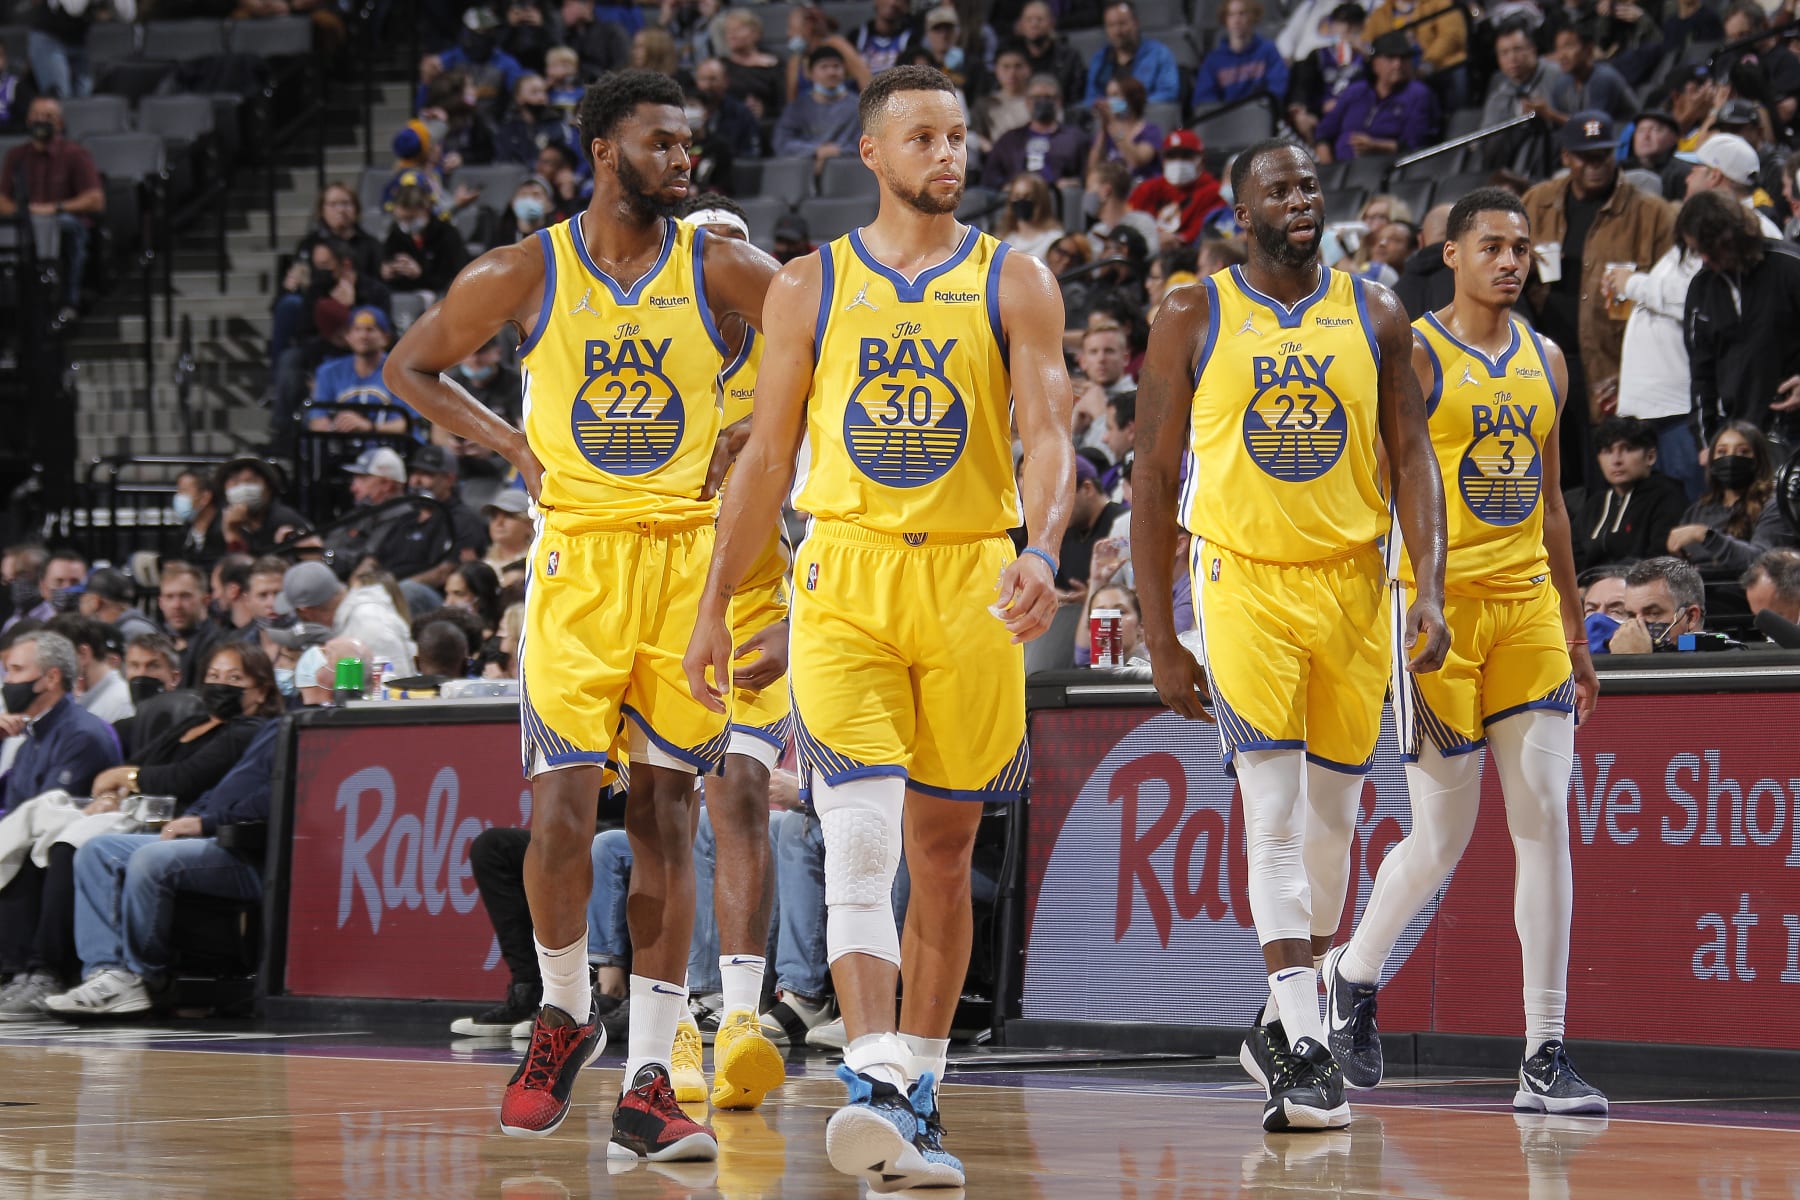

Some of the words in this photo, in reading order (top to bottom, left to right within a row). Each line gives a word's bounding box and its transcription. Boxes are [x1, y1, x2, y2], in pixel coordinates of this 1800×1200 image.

[649, 295, 690, 308] Rakuten
[934, 291, 980, 303] Rakuten
[613, 323, 640, 340] The
[891, 321, 921, 339] The
[1315, 317, 1353, 327] Rakuten
[585, 338, 673, 377] BAY
[858, 337, 958, 379] BAY
[1278, 341, 1303, 355] The
[1252, 354, 1335, 389] BAY
[604, 380, 653, 419] 22
[730, 388, 755, 398] Rakut
[880, 383, 932, 427] 30
[1493, 391, 1512, 405] The
[1274, 394, 1319, 430] 23
[1471, 404, 1538, 438] BAY
[1497, 440, 1515, 475] 3
[1691, 893, 1758, 982] at
